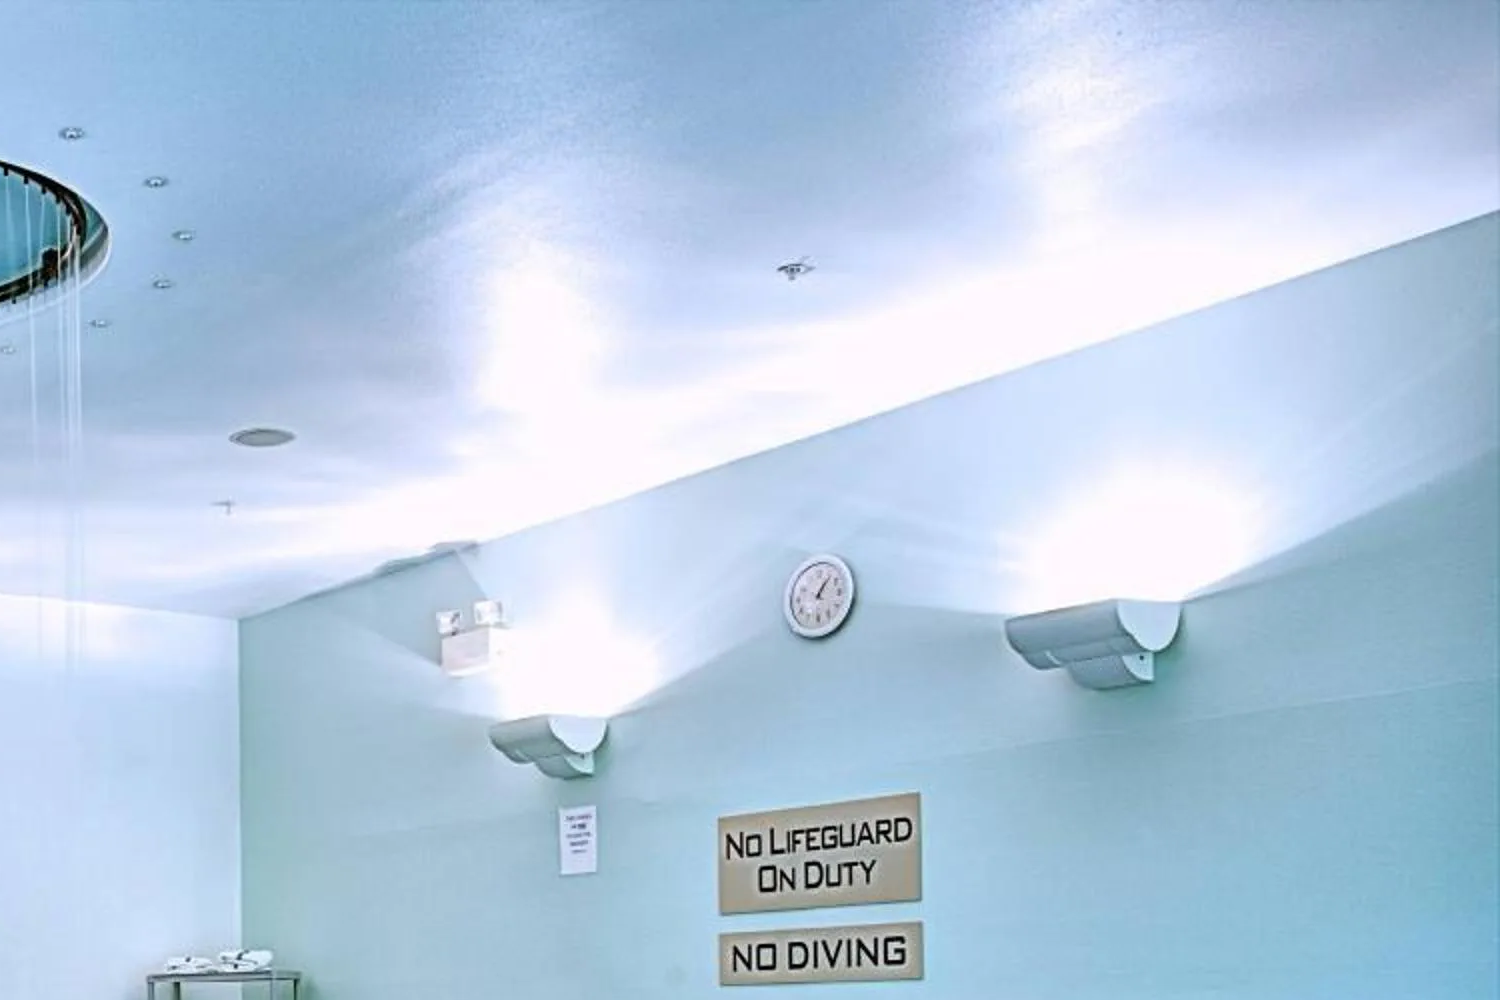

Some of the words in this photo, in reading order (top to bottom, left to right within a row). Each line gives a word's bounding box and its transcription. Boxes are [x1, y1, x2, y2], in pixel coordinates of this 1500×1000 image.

[726, 832, 762, 859] NO
[770, 818, 913, 855] LIFEGUARD
[759, 865, 796, 892] ON
[804, 860, 877, 889] DUTY
[733, 943, 777, 972] NO
[788, 936, 906, 970] DIVING
